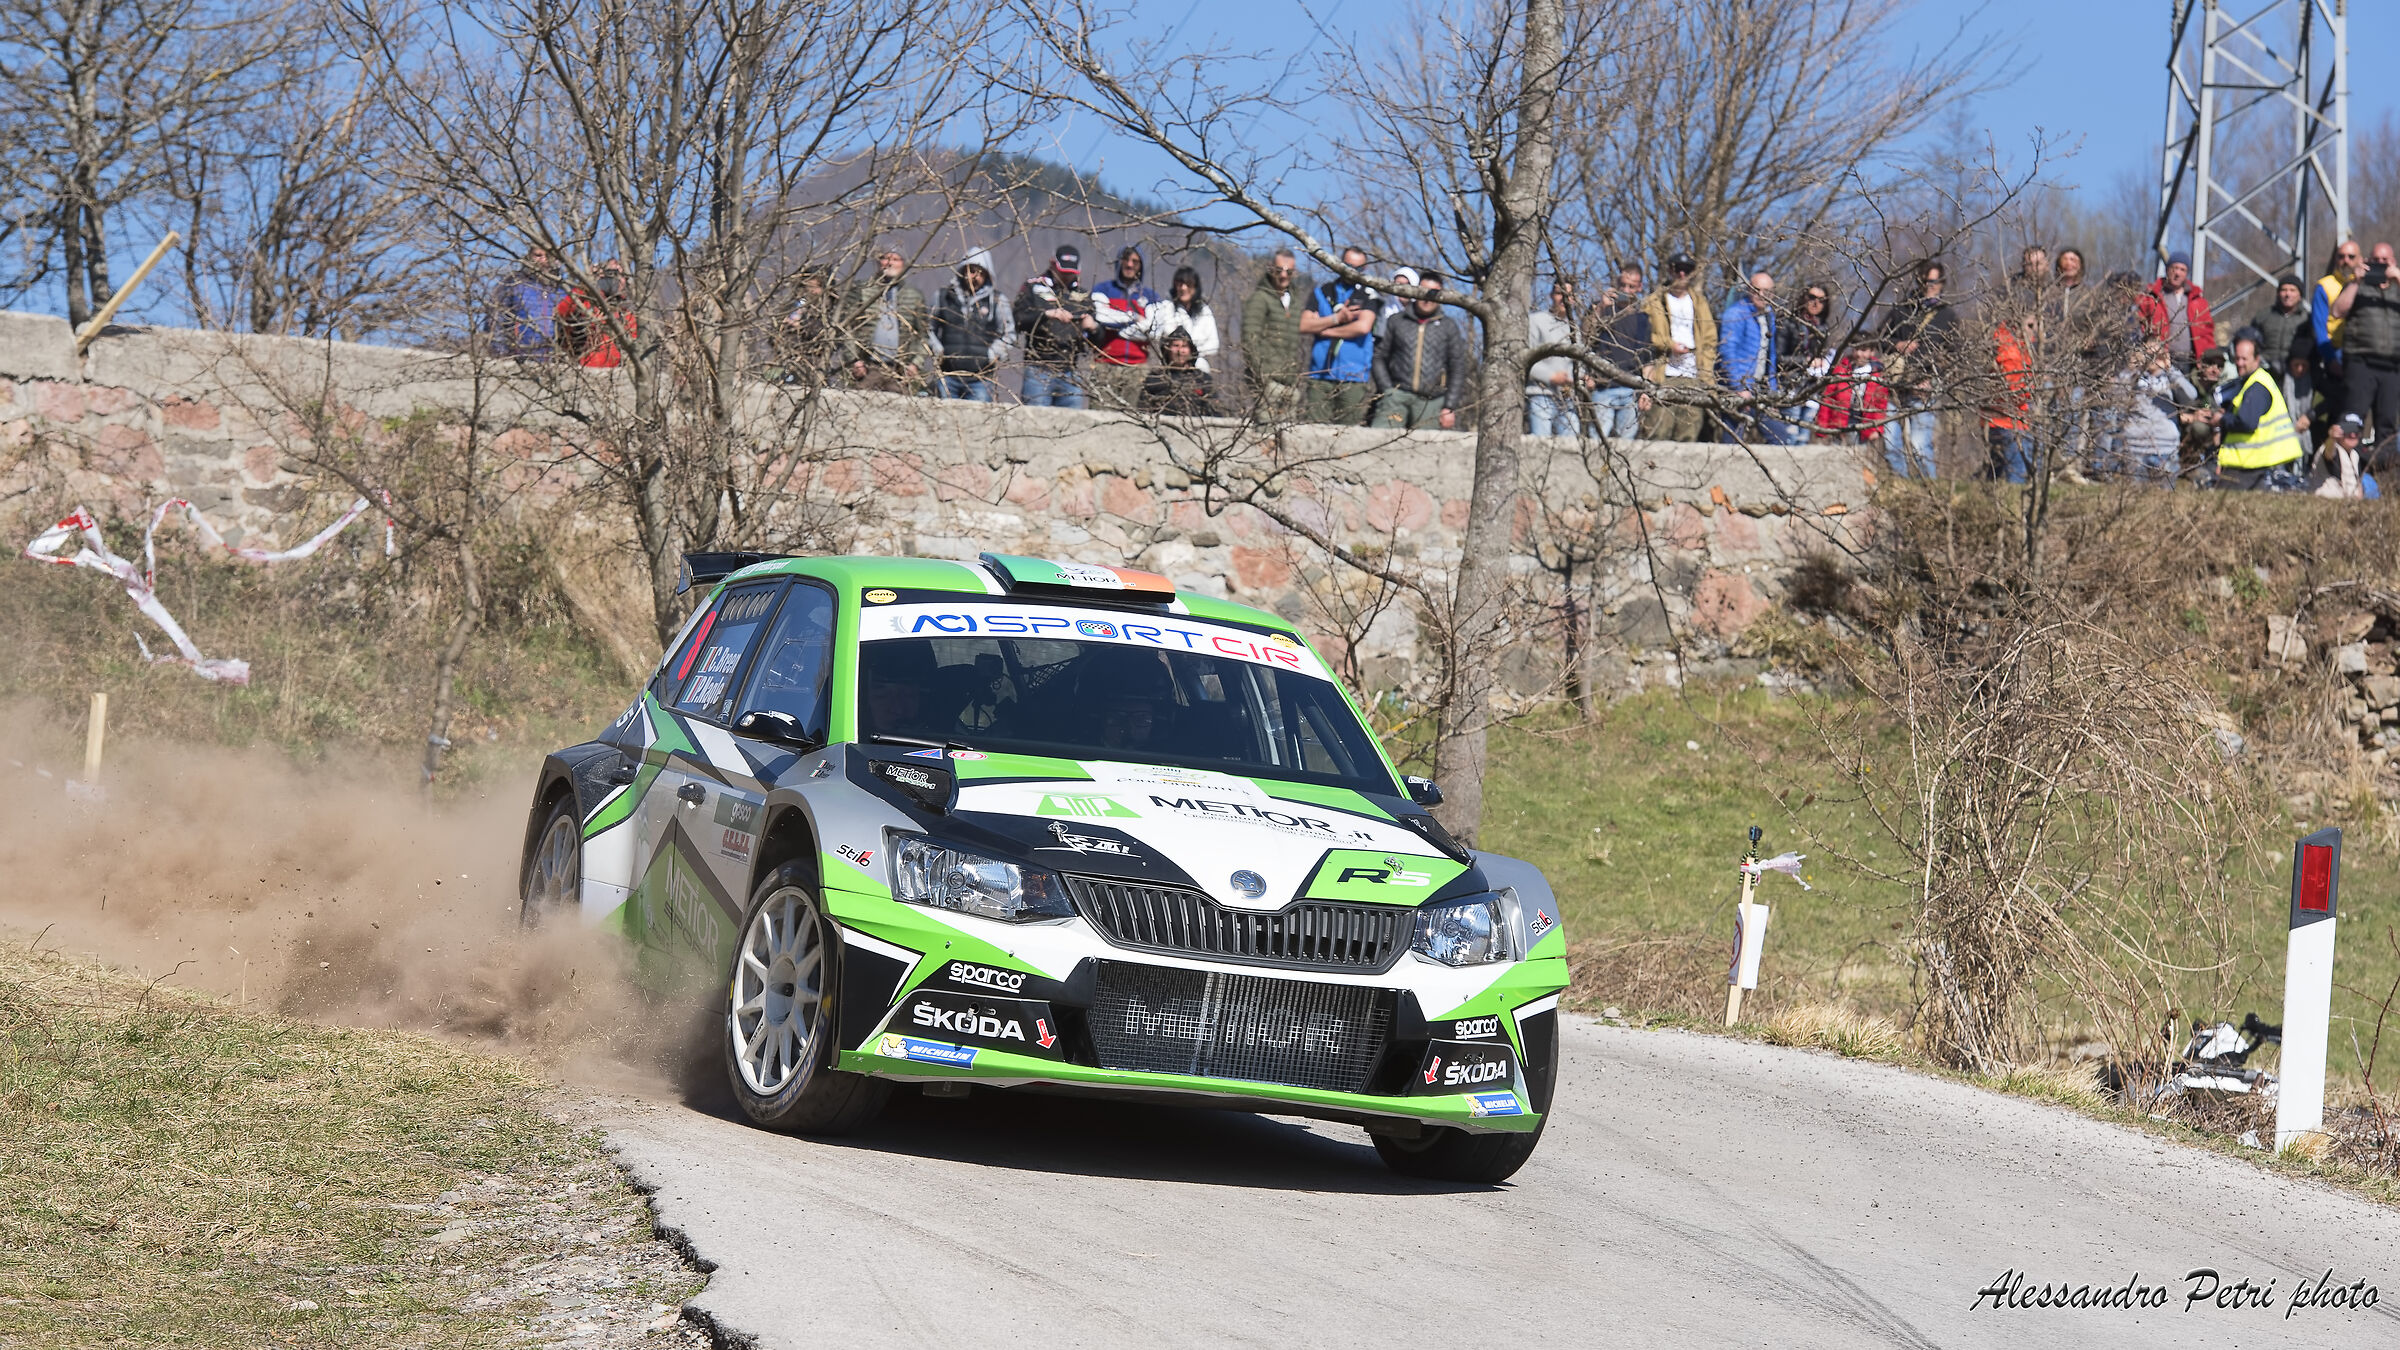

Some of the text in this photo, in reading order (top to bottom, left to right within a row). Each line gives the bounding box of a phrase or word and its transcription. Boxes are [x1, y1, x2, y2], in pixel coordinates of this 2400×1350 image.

[989, 614, 1204, 648] SPORT
[1212, 636, 1301, 669] CIR
[1337, 867, 1432, 887] R5
[949, 961, 1024, 991] sparco
[913, 1000, 1026, 1041] ŠKODA
[1455, 1018, 1498, 1038] sparco
[909, 1045, 972, 1061] MICHELIN
[1444, 1060, 1508, 1086] ŠKODA
[1484, 1098, 1517, 1109] MICHELIN
